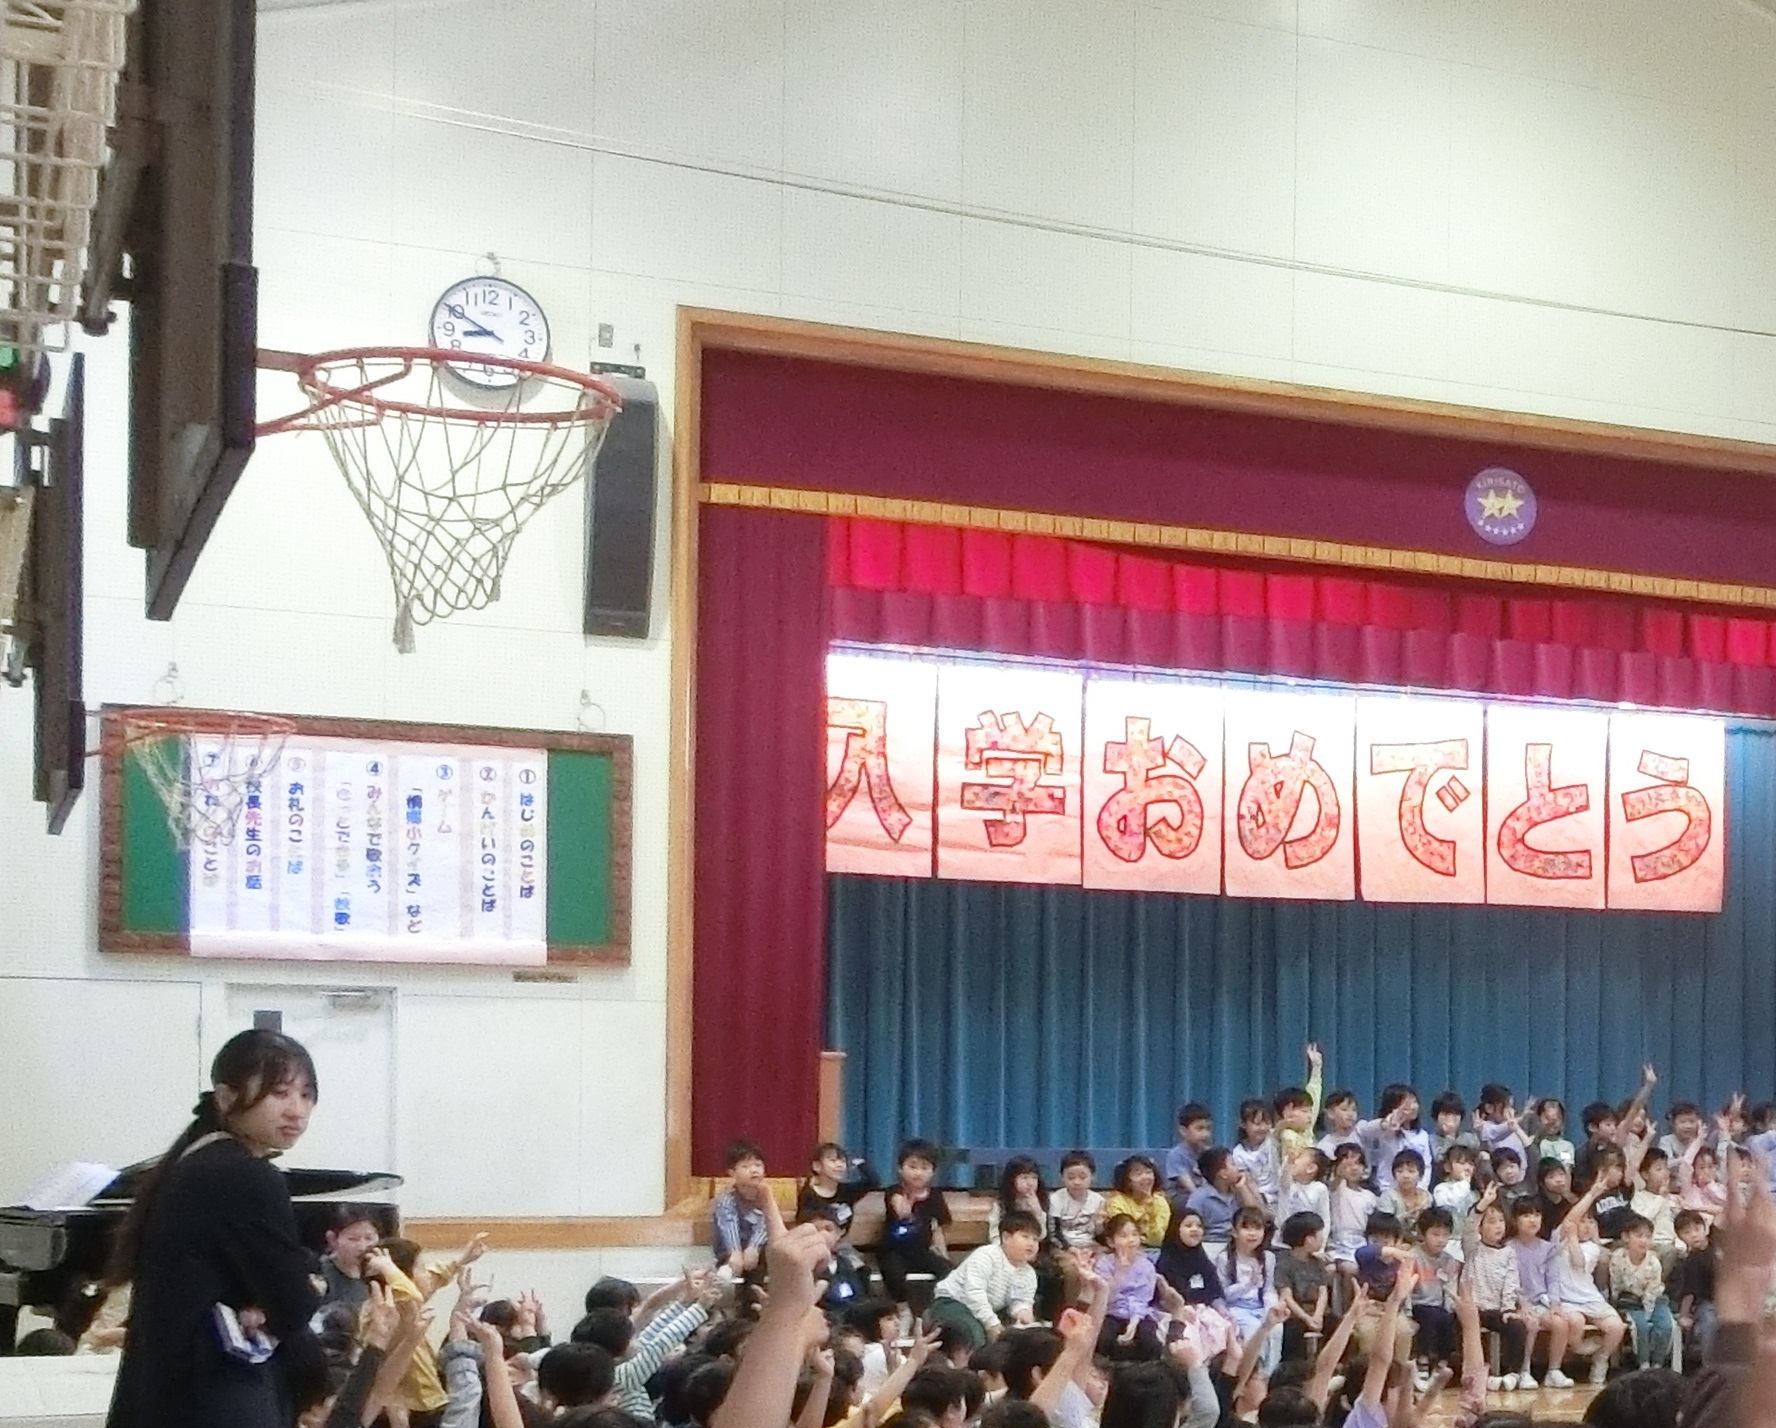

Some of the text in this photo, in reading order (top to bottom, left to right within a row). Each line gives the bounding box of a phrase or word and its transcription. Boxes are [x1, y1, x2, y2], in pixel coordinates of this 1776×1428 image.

[464, 289, 478, 306] 11
[482, 289, 499, 306] 12
[507, 296, 513, 310] 1
[519, 310, 530, 326] 2
[442, 321, 455, 337] 9
[523, 329, 536, 345] 3
[825, 695, 1713, 885] 入学おめでとう
